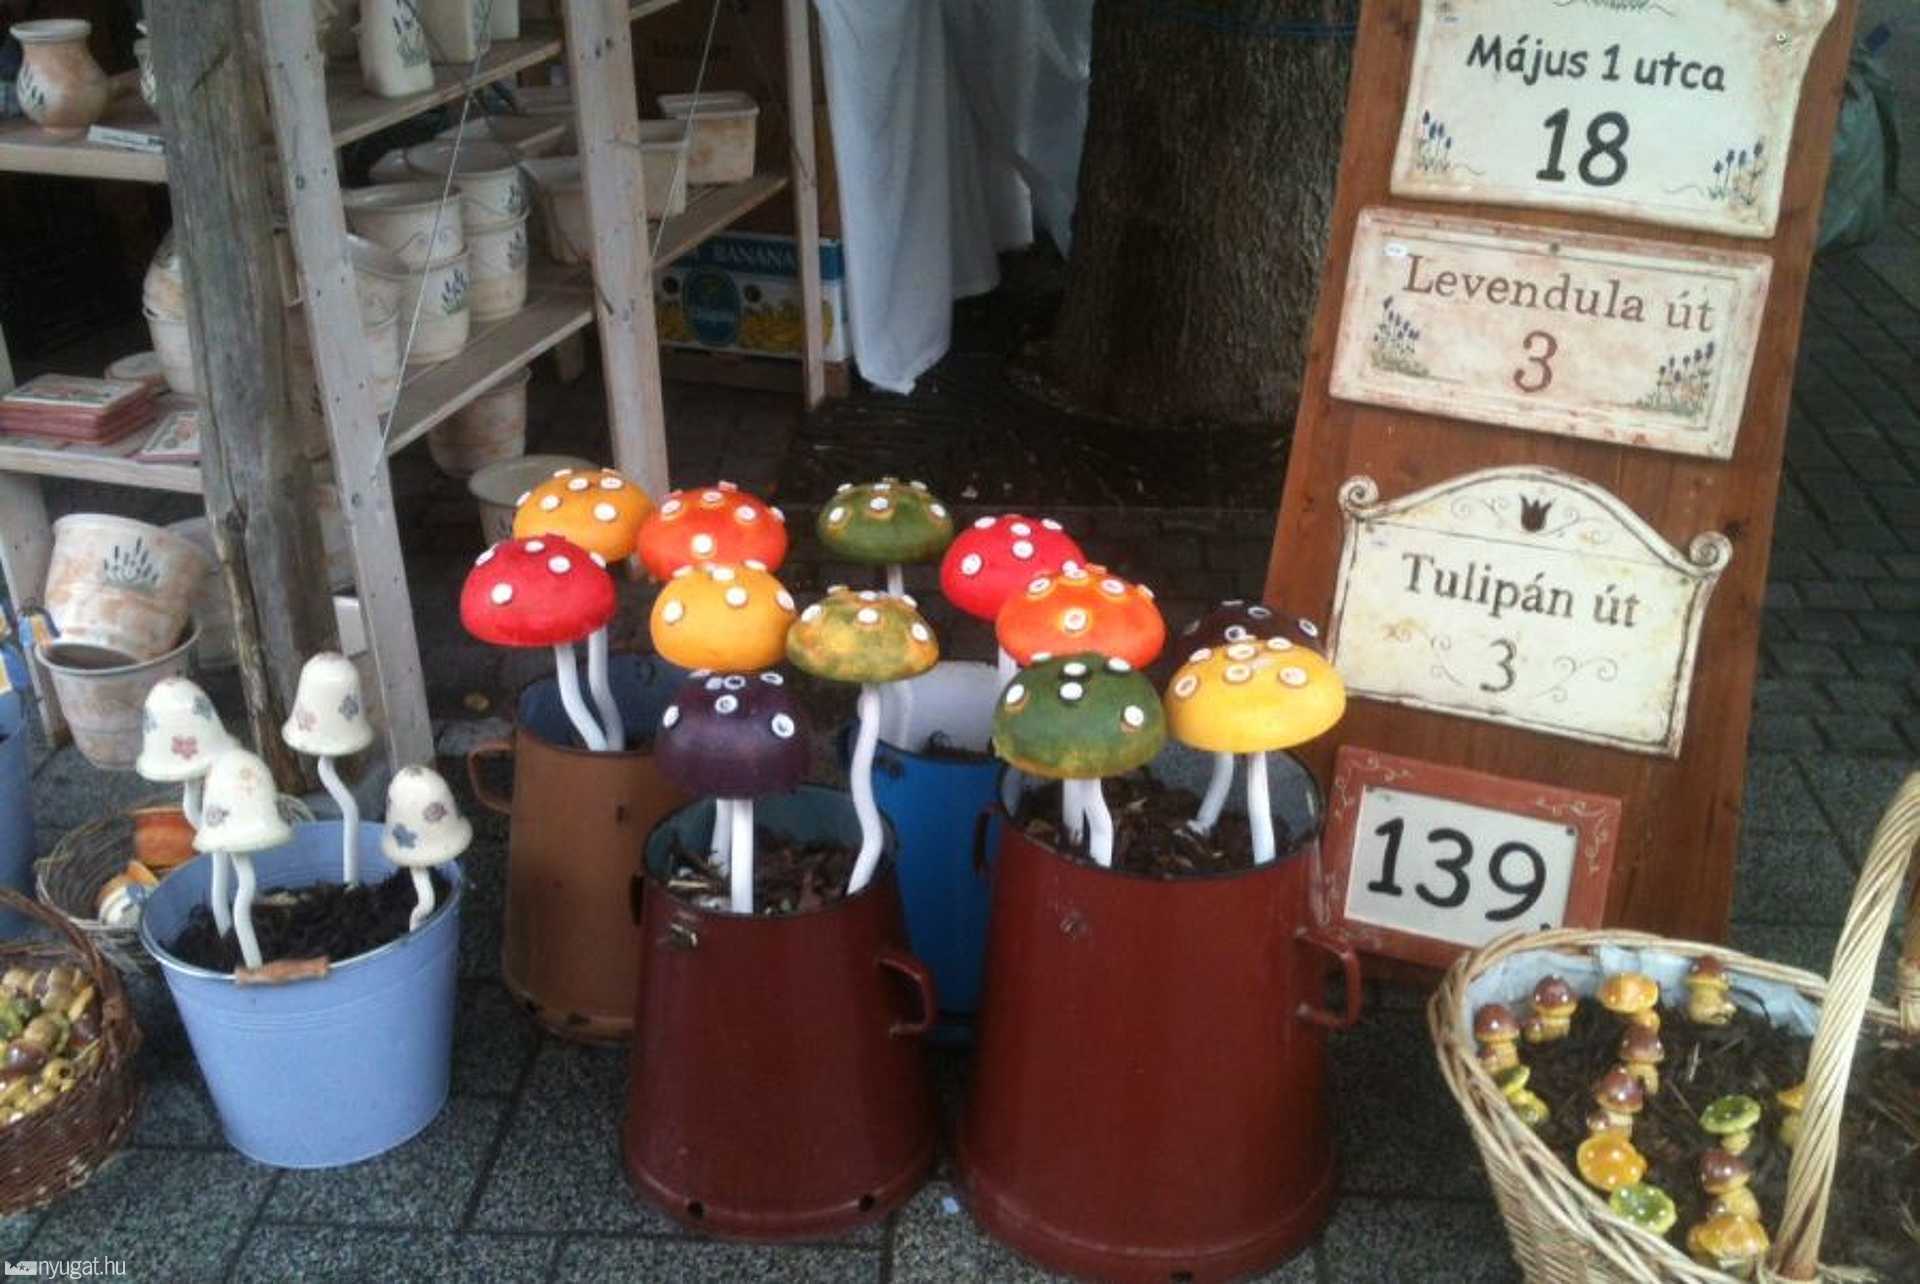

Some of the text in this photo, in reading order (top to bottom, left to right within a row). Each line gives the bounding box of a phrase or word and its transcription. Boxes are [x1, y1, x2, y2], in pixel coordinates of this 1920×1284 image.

[1466, 34, 1727, 93] Május 1 utca
[1535, 107, 1631, 188] 18
[1402, 255, 1714, 333] Levendula út
[1512, 330, 1559, 394] 3
[1402, 551, 1641, 629] Tulipán út
[1479, 638, 1518, 694] 3
[1366, 816, 1548, 923] 139
